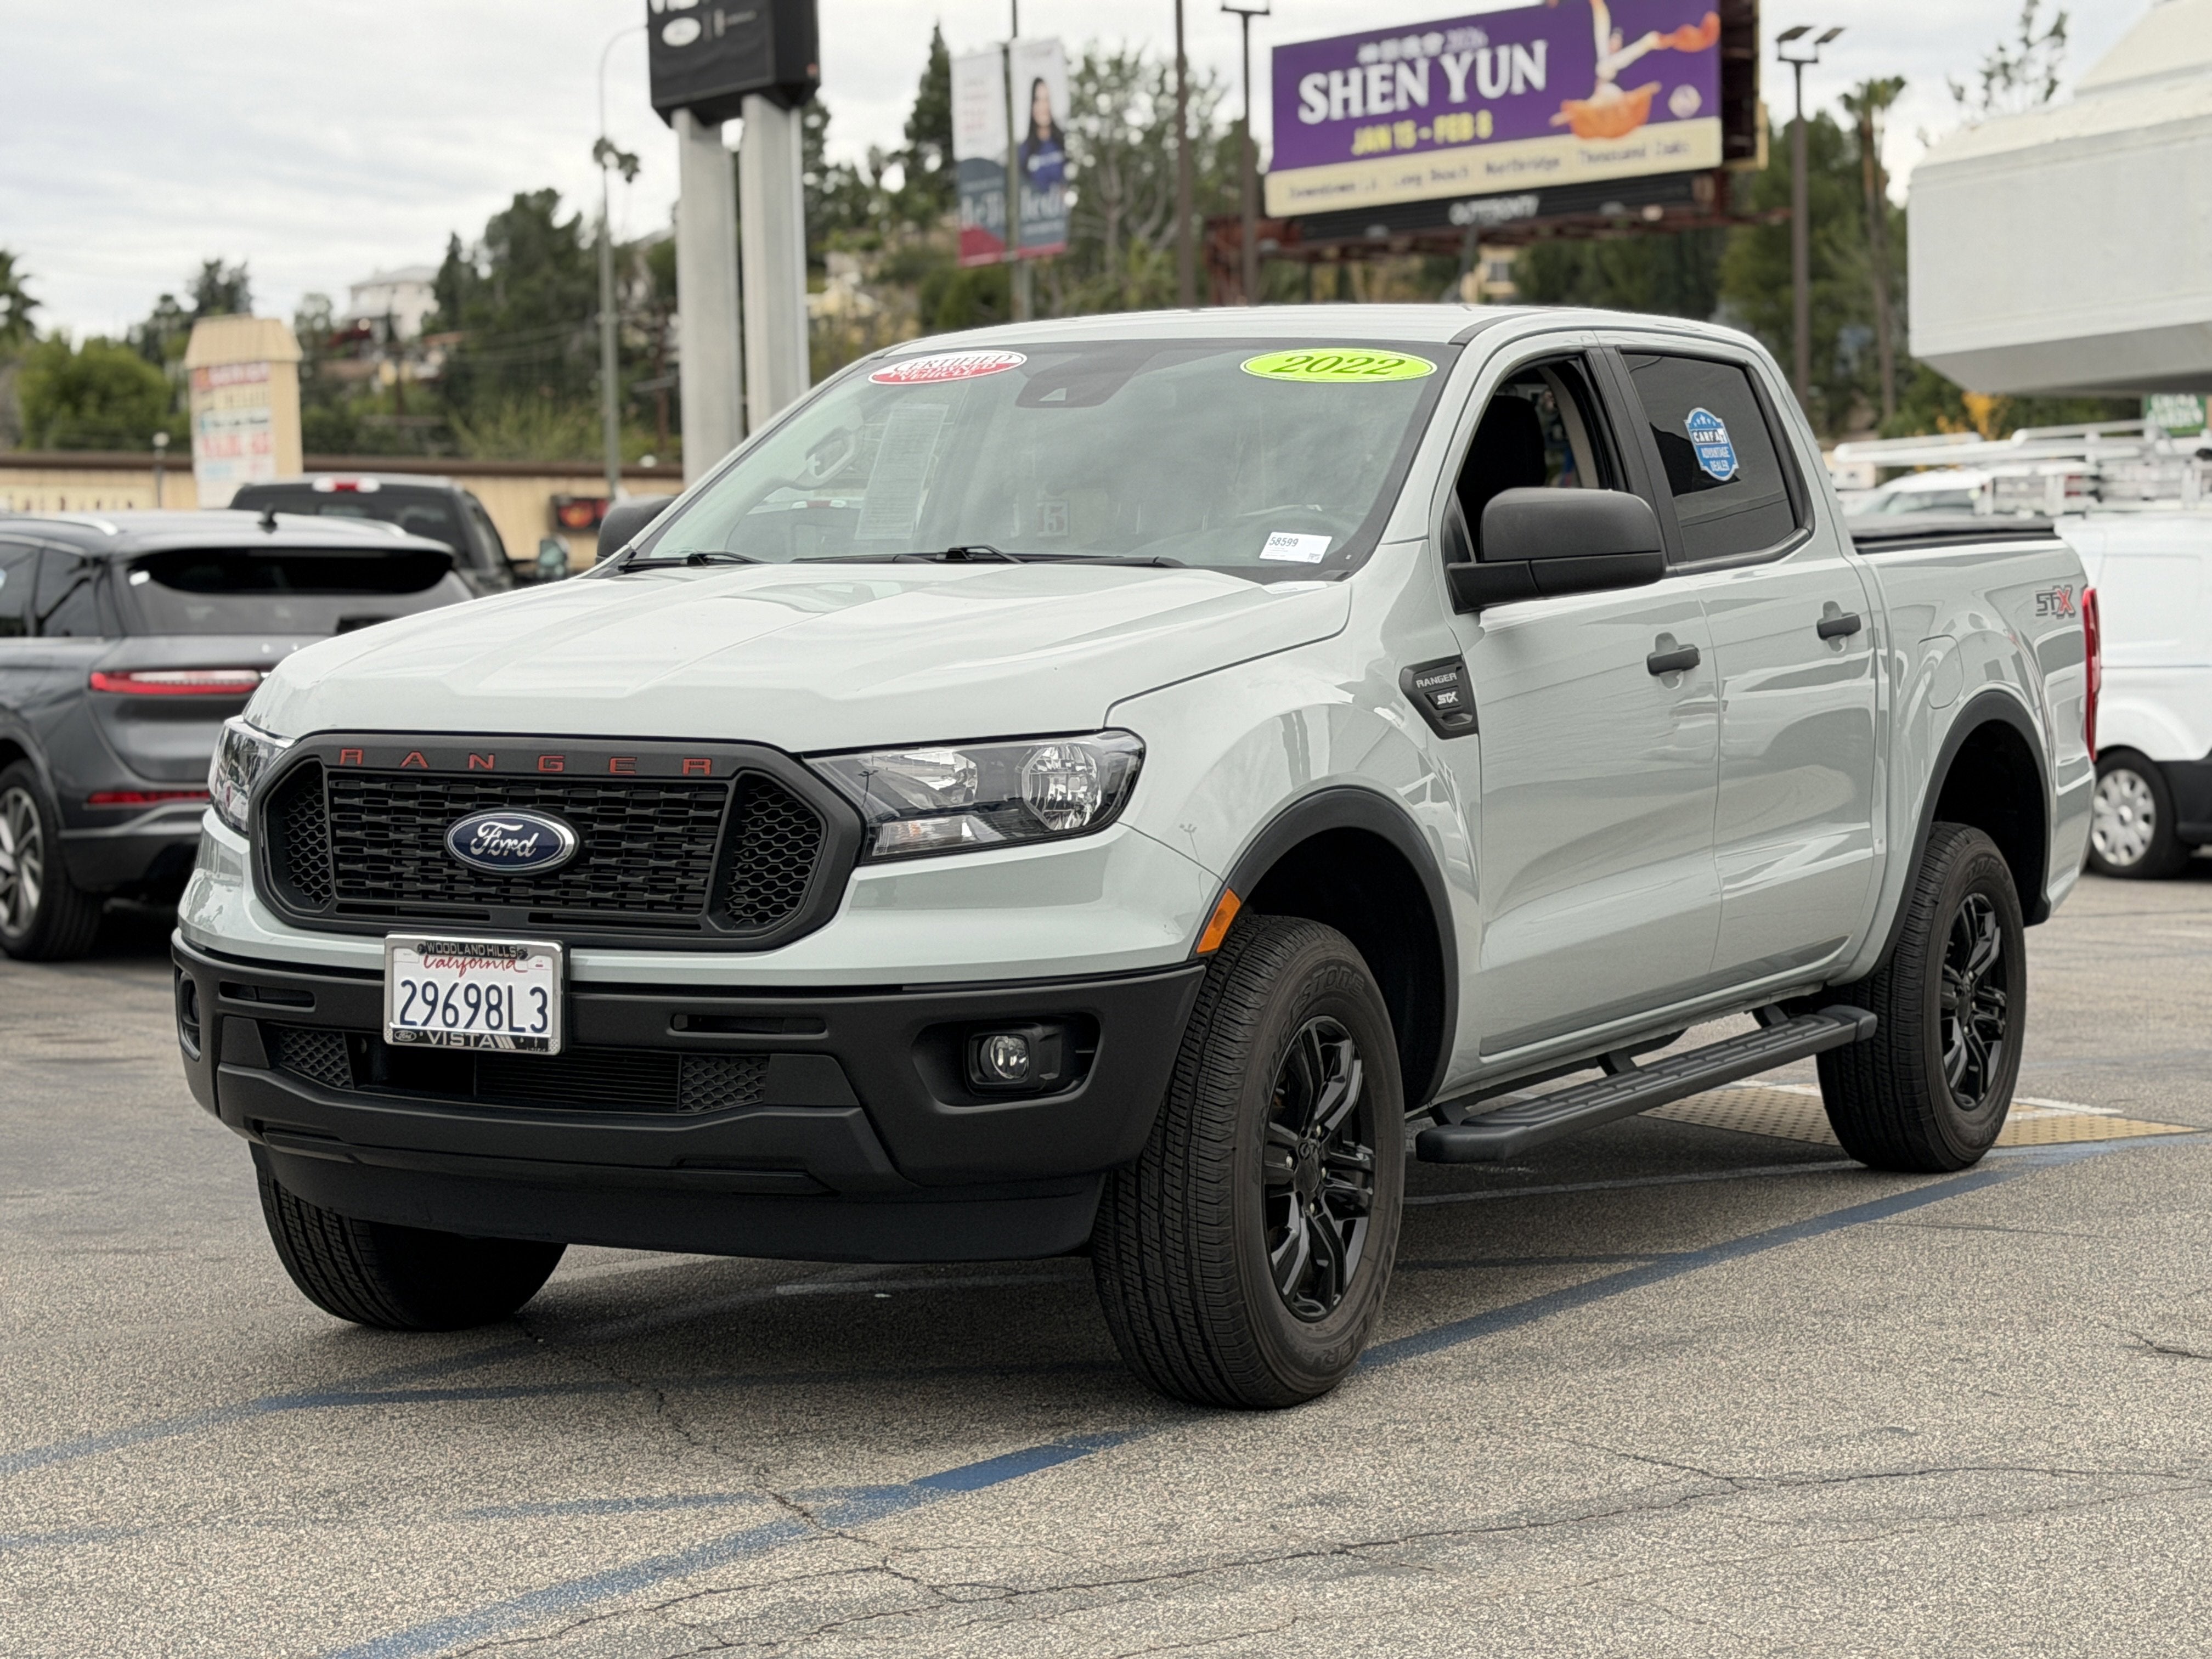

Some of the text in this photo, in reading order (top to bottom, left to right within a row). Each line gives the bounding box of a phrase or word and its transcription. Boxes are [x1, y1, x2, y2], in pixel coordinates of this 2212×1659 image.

[1298, 57, 1429, 125] SHEN
[1438, 39, 1548, 103] YUN
[1351, 123, 1392, 155] JAN
[1433, 112, 1474, 144] FEB
[1269, 356, 1406, 375] 2022
[1692, 430, 1728, 443] CARFAX
[1268, 537, 1299, 547] 58599
[2035, 585, 2076, 619] STX
[1415, 673, 1458, 688] RANGER
[1436, 691, 1459, 705] STX
[339, 748, 712, 776] RANGER
[470, 821, 539, 857] Ford
[426, 942, 517, 957] WOODLAND HILLS
[423, 955, 528, 978] California
[399, 979, 548, 1034] 29698L3
[426, 1030, 495, 1048] VISTA
